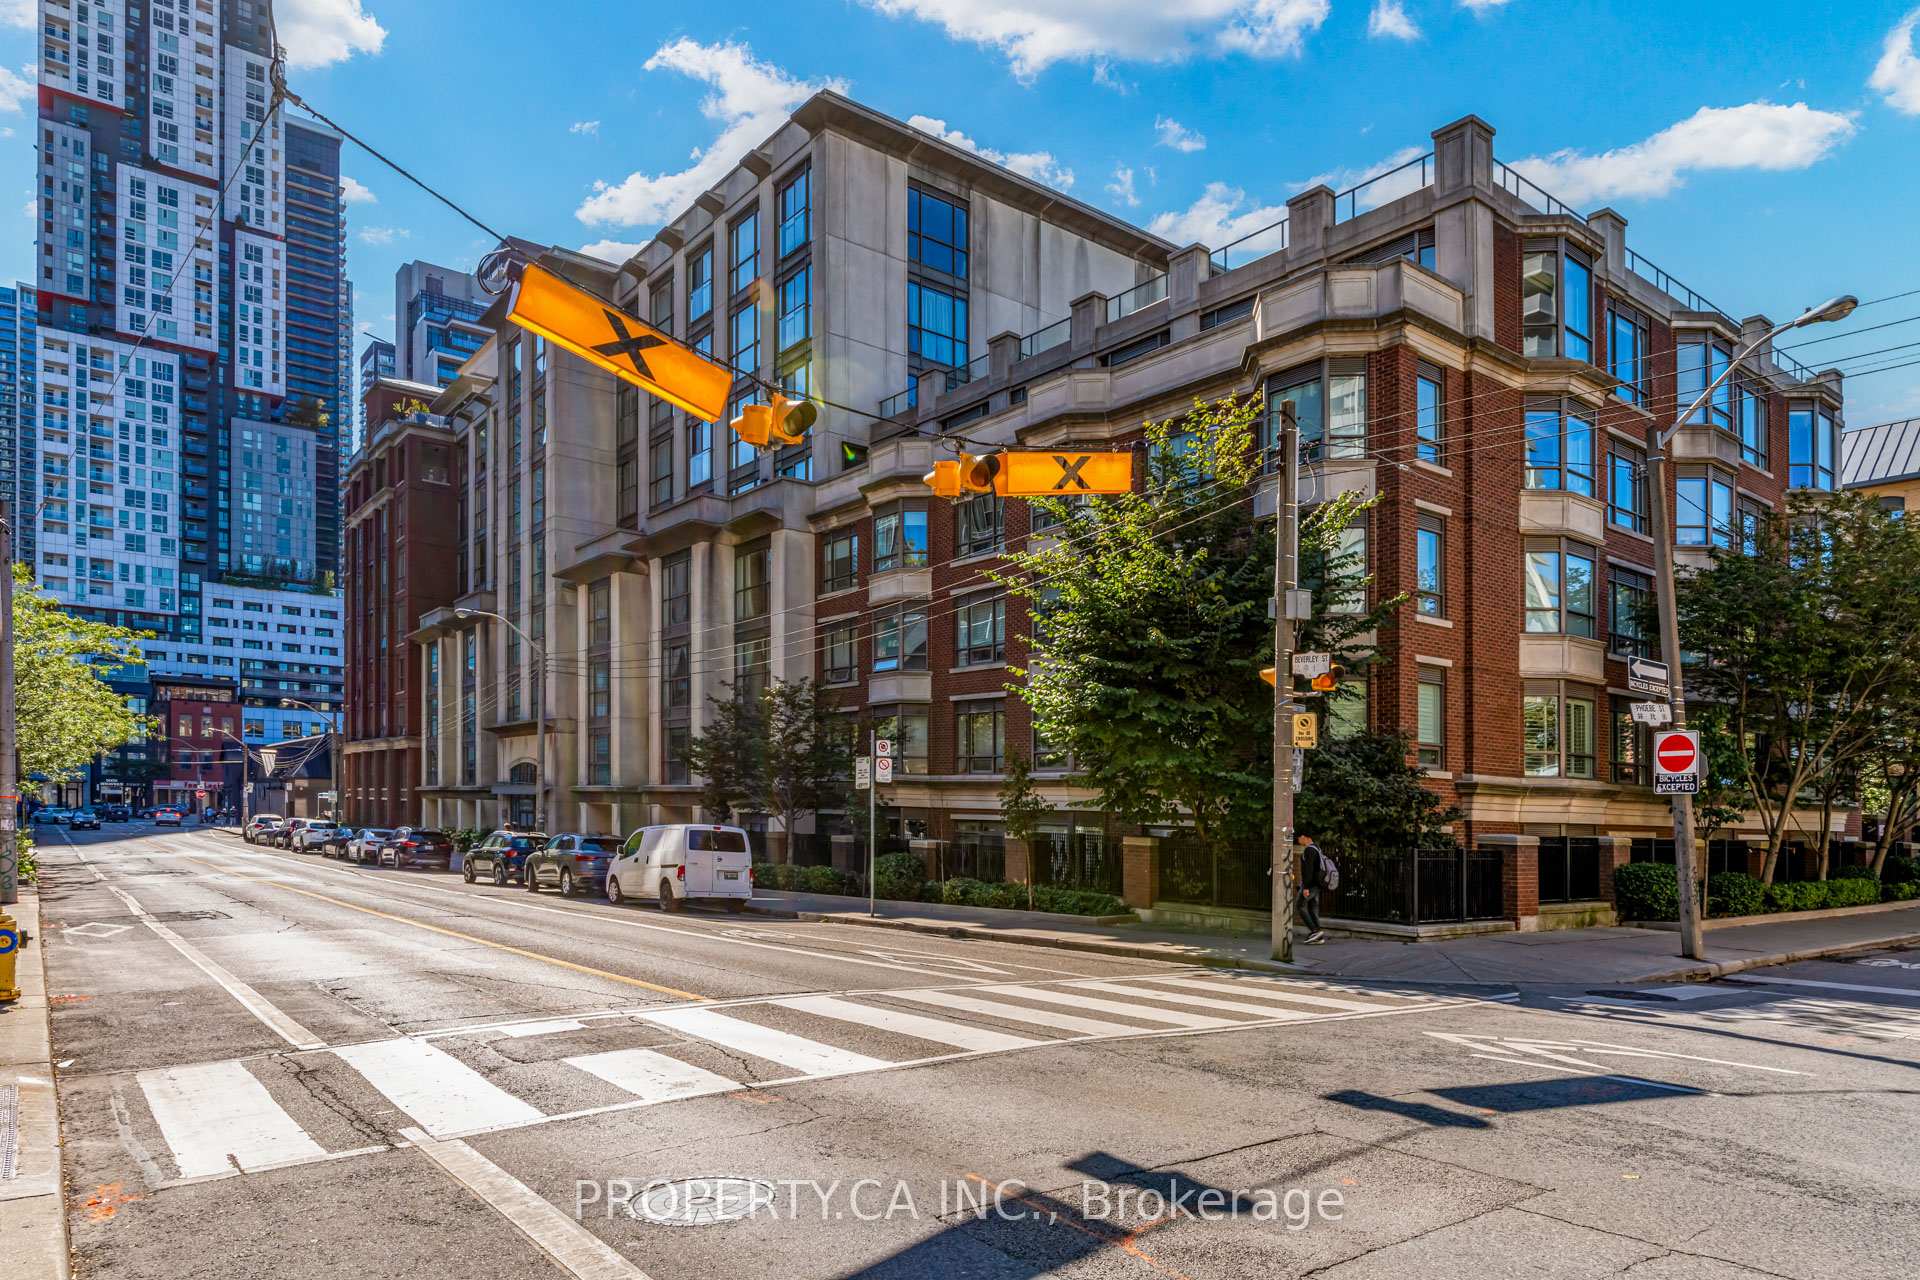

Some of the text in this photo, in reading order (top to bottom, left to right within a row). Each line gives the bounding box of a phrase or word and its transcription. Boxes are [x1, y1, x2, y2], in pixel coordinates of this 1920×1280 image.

[1295, 655, 1319, 663] BEVERLEY
[1649, 684, 1669, 694] EXCEPTED
[1635, 704, 1665, 712] PHOEBE ST
[1657, 783, 1695, 791] EXCEPTED
